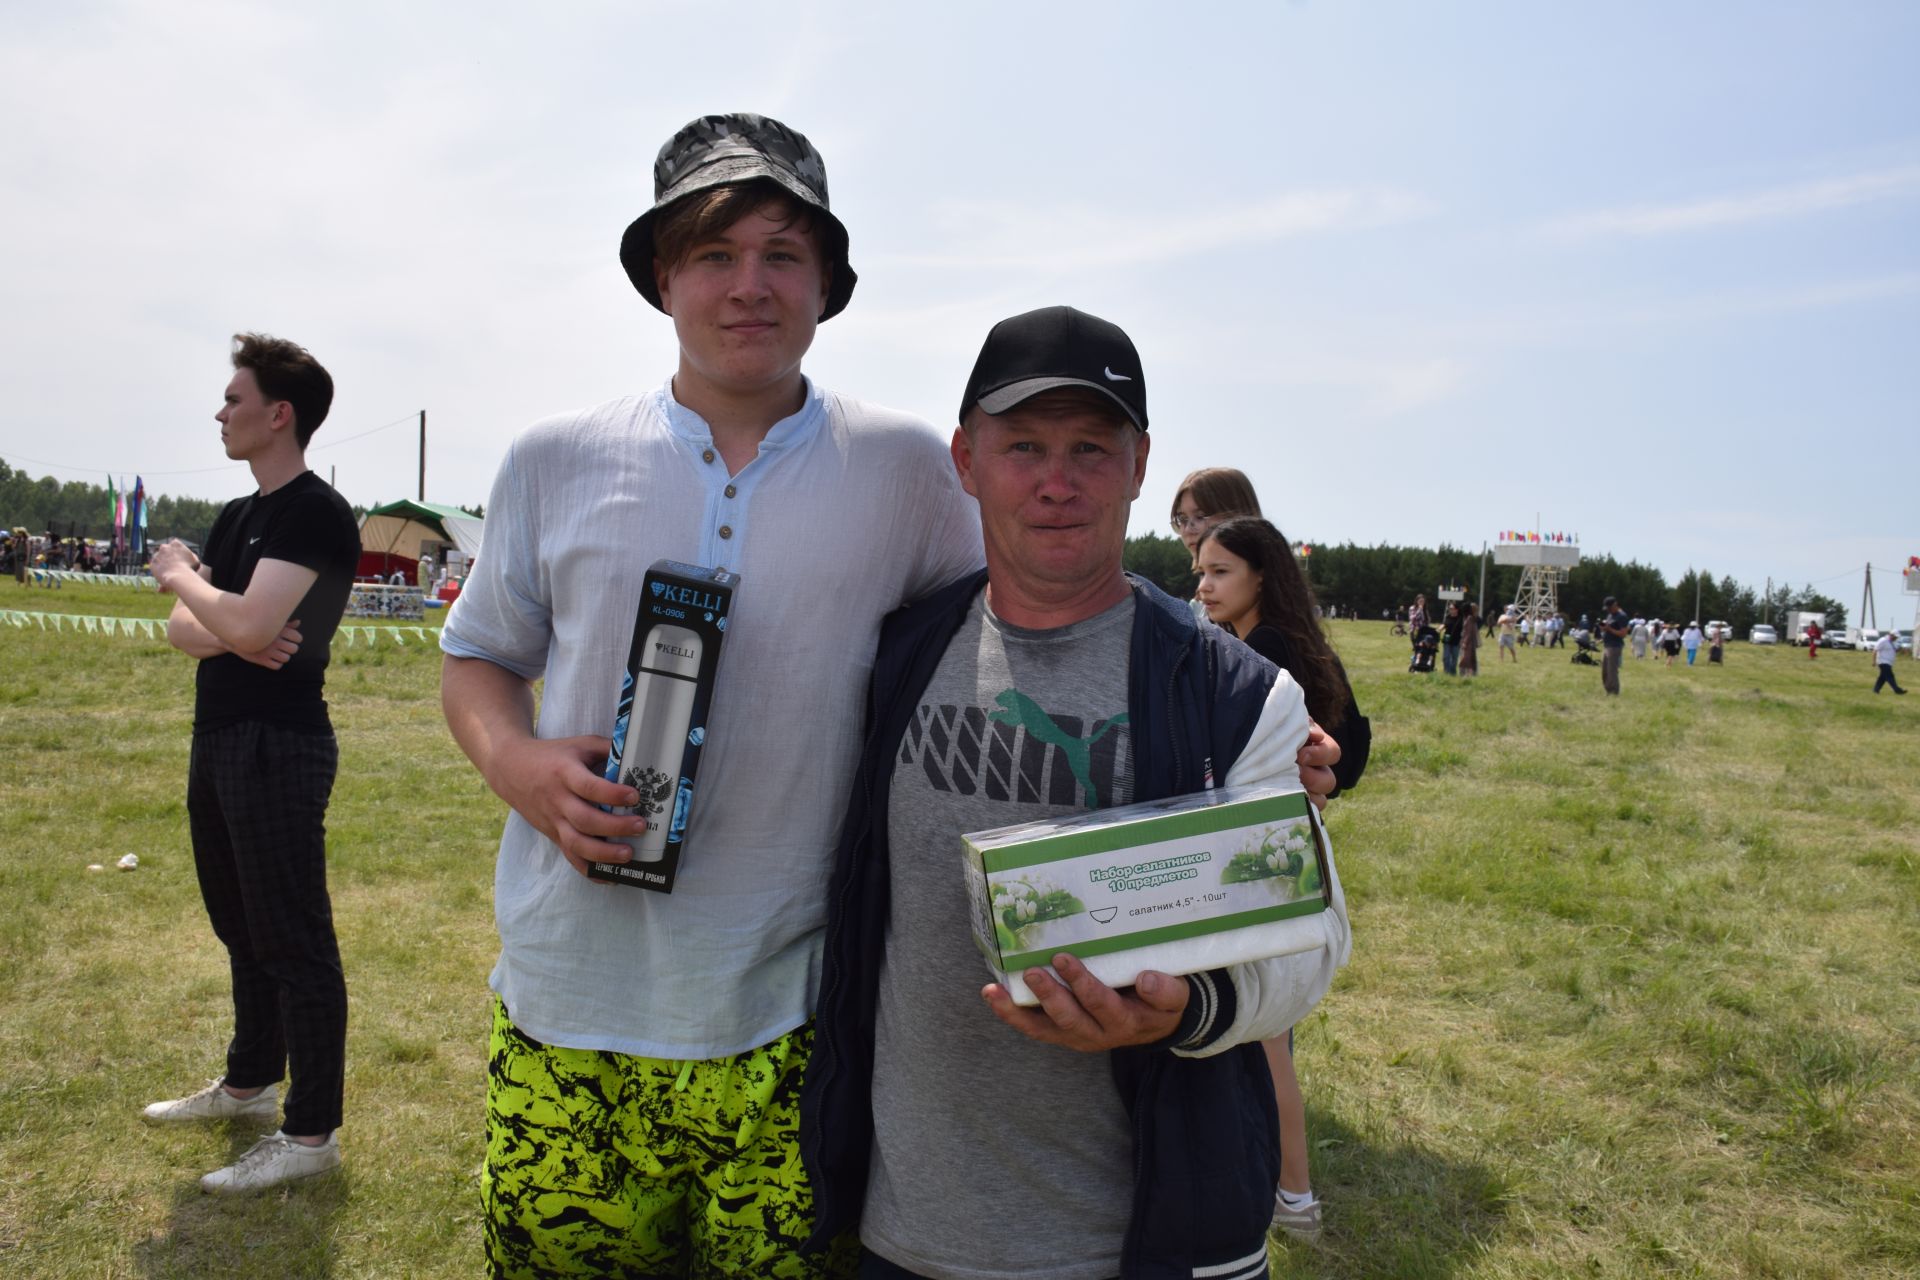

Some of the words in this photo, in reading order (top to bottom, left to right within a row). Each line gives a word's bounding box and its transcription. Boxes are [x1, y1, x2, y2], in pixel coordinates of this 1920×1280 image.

[664, 584, 722, 611] KELLI
[662, 644, 695, 658] KELLI
[1090, 865, 1133, 882] Набор
[1134, 852, 1211, 874] салатников
[1109, 879, 1126, 892] 10
[1127, 868, 1198, 890] предметов
[1129, 901, 1174, 917] салатник
[1202, 891, 1228, 903] 10шт
